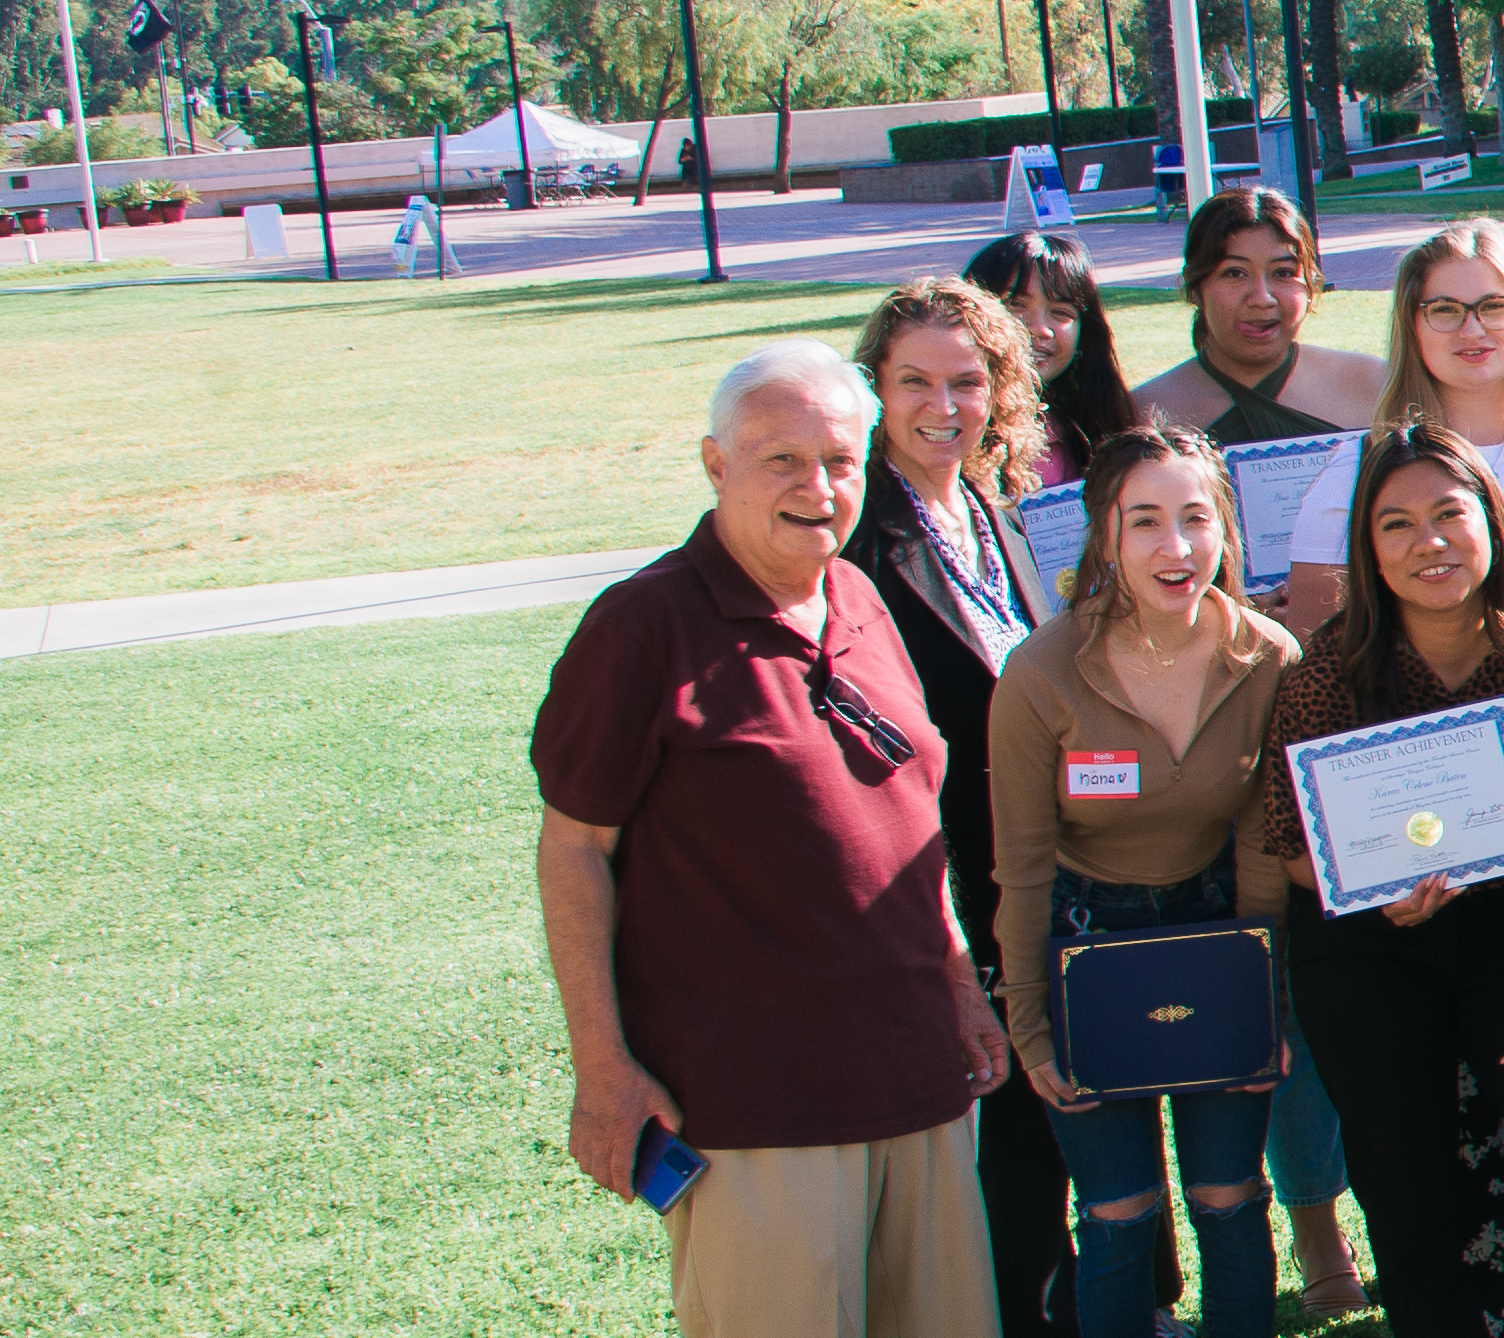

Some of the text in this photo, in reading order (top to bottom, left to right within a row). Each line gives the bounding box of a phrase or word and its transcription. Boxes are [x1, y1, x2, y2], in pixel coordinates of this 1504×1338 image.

[1250, 458, 1305, 473] TRANSFER
[1046, 505, 1083, 521] ACHIEV
[1093, 752, 1115, 760] Hello
[1330, 748, 1393, 772] TRANSFER
[1396, 726, 1485, 757] ACHIEVEMENT
